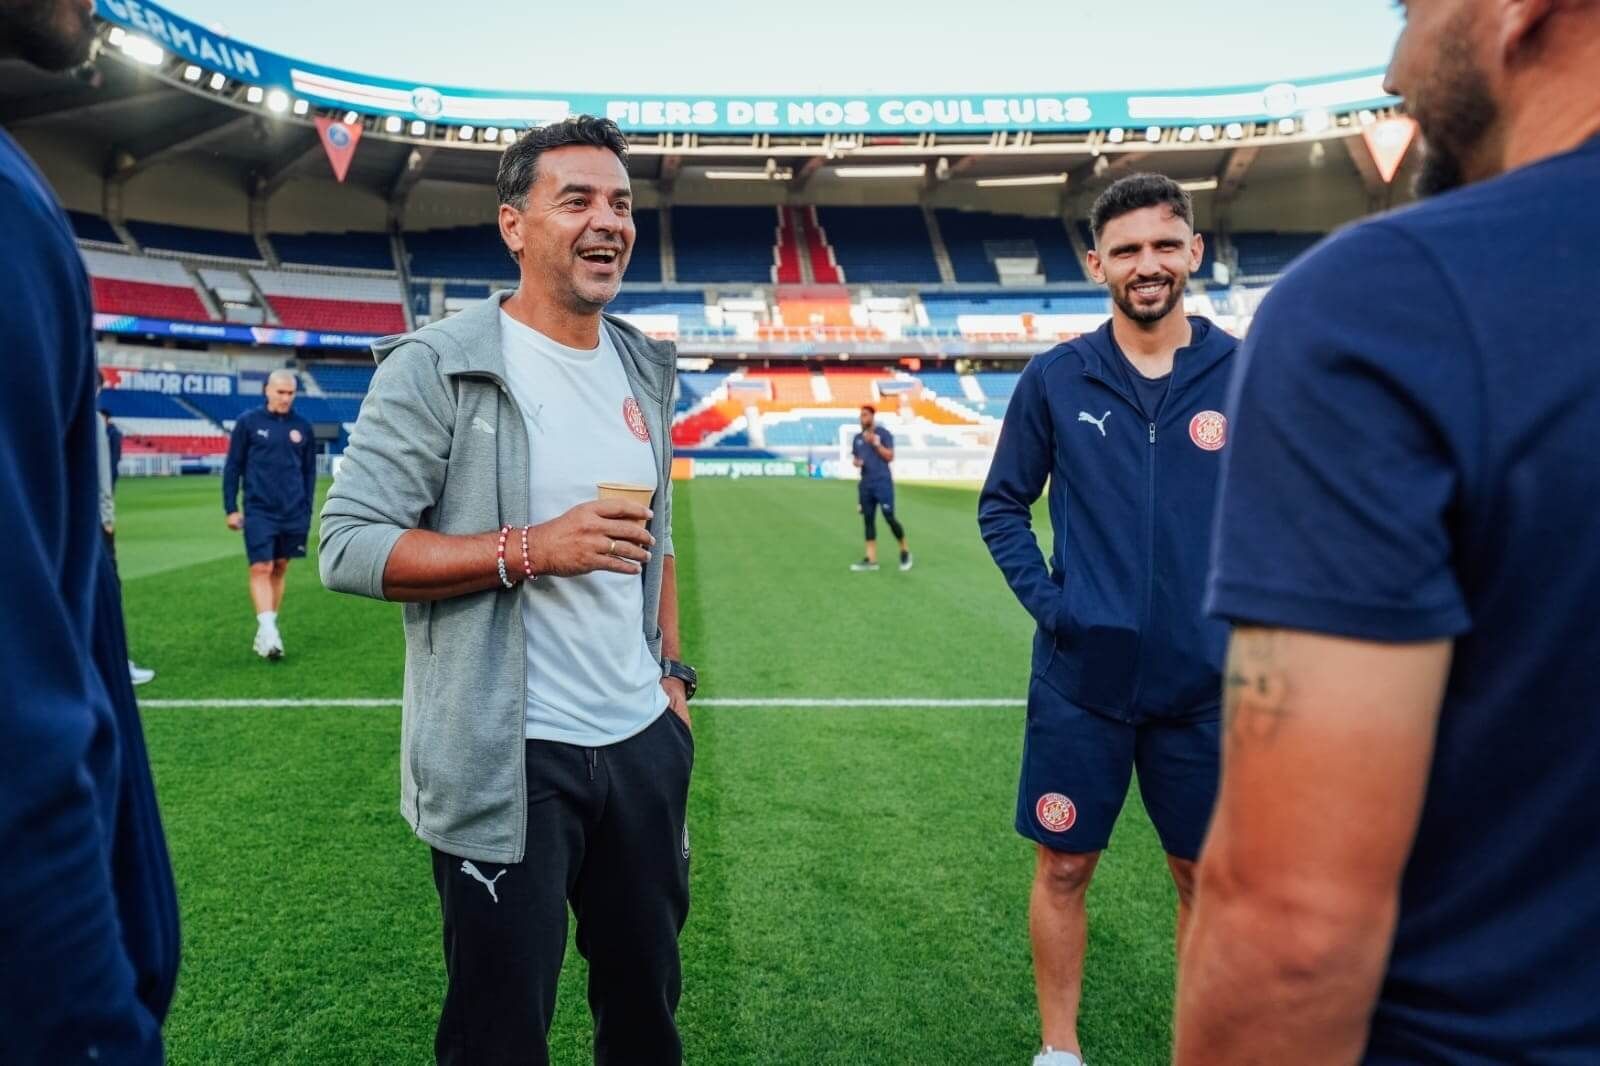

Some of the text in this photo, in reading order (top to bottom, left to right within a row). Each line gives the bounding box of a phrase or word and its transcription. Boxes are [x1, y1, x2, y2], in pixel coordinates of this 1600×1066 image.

[104, 0, 260, 78] GERMAIN
[606, 97, 1093, 126] FIERS DE NOS COULEURS
[183, 374, 231, 395] CLUB
